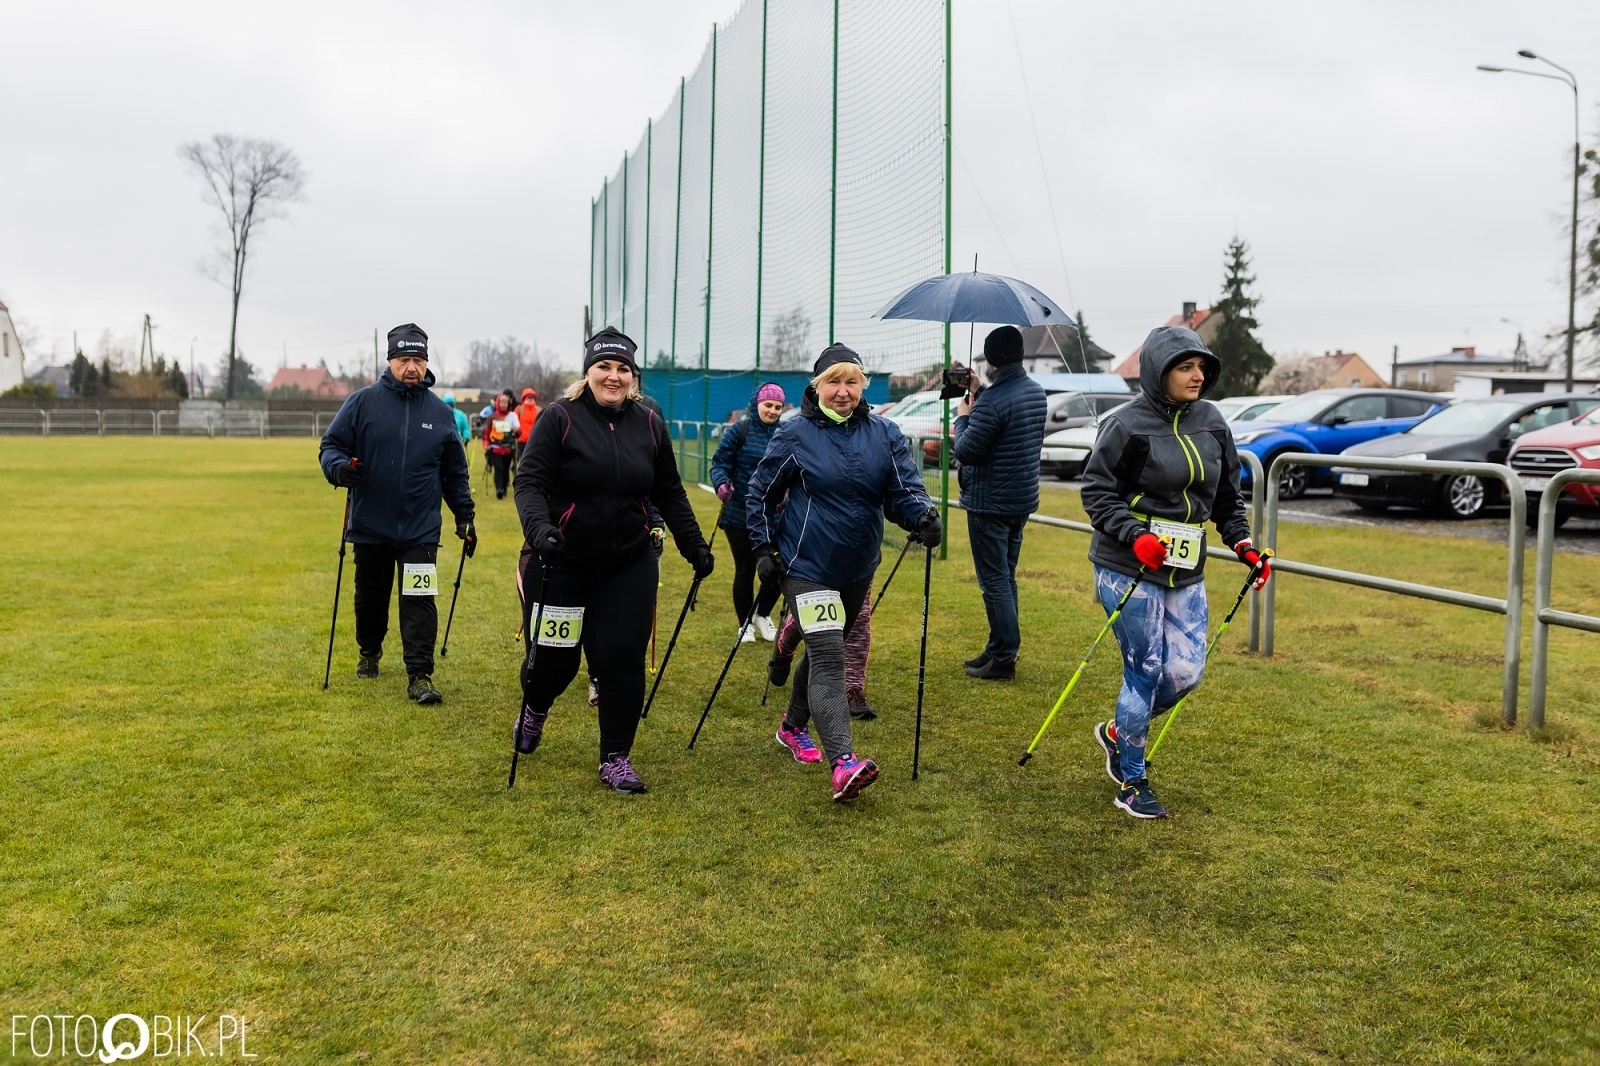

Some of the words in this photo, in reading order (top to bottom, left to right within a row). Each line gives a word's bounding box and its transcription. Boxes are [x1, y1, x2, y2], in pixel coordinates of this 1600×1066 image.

[1170, 537, 1190, 559] 15
[413, 574, 431, 589] 29
[814, 603, 838, 623] 20
[544, 620, 570, 639] 36
